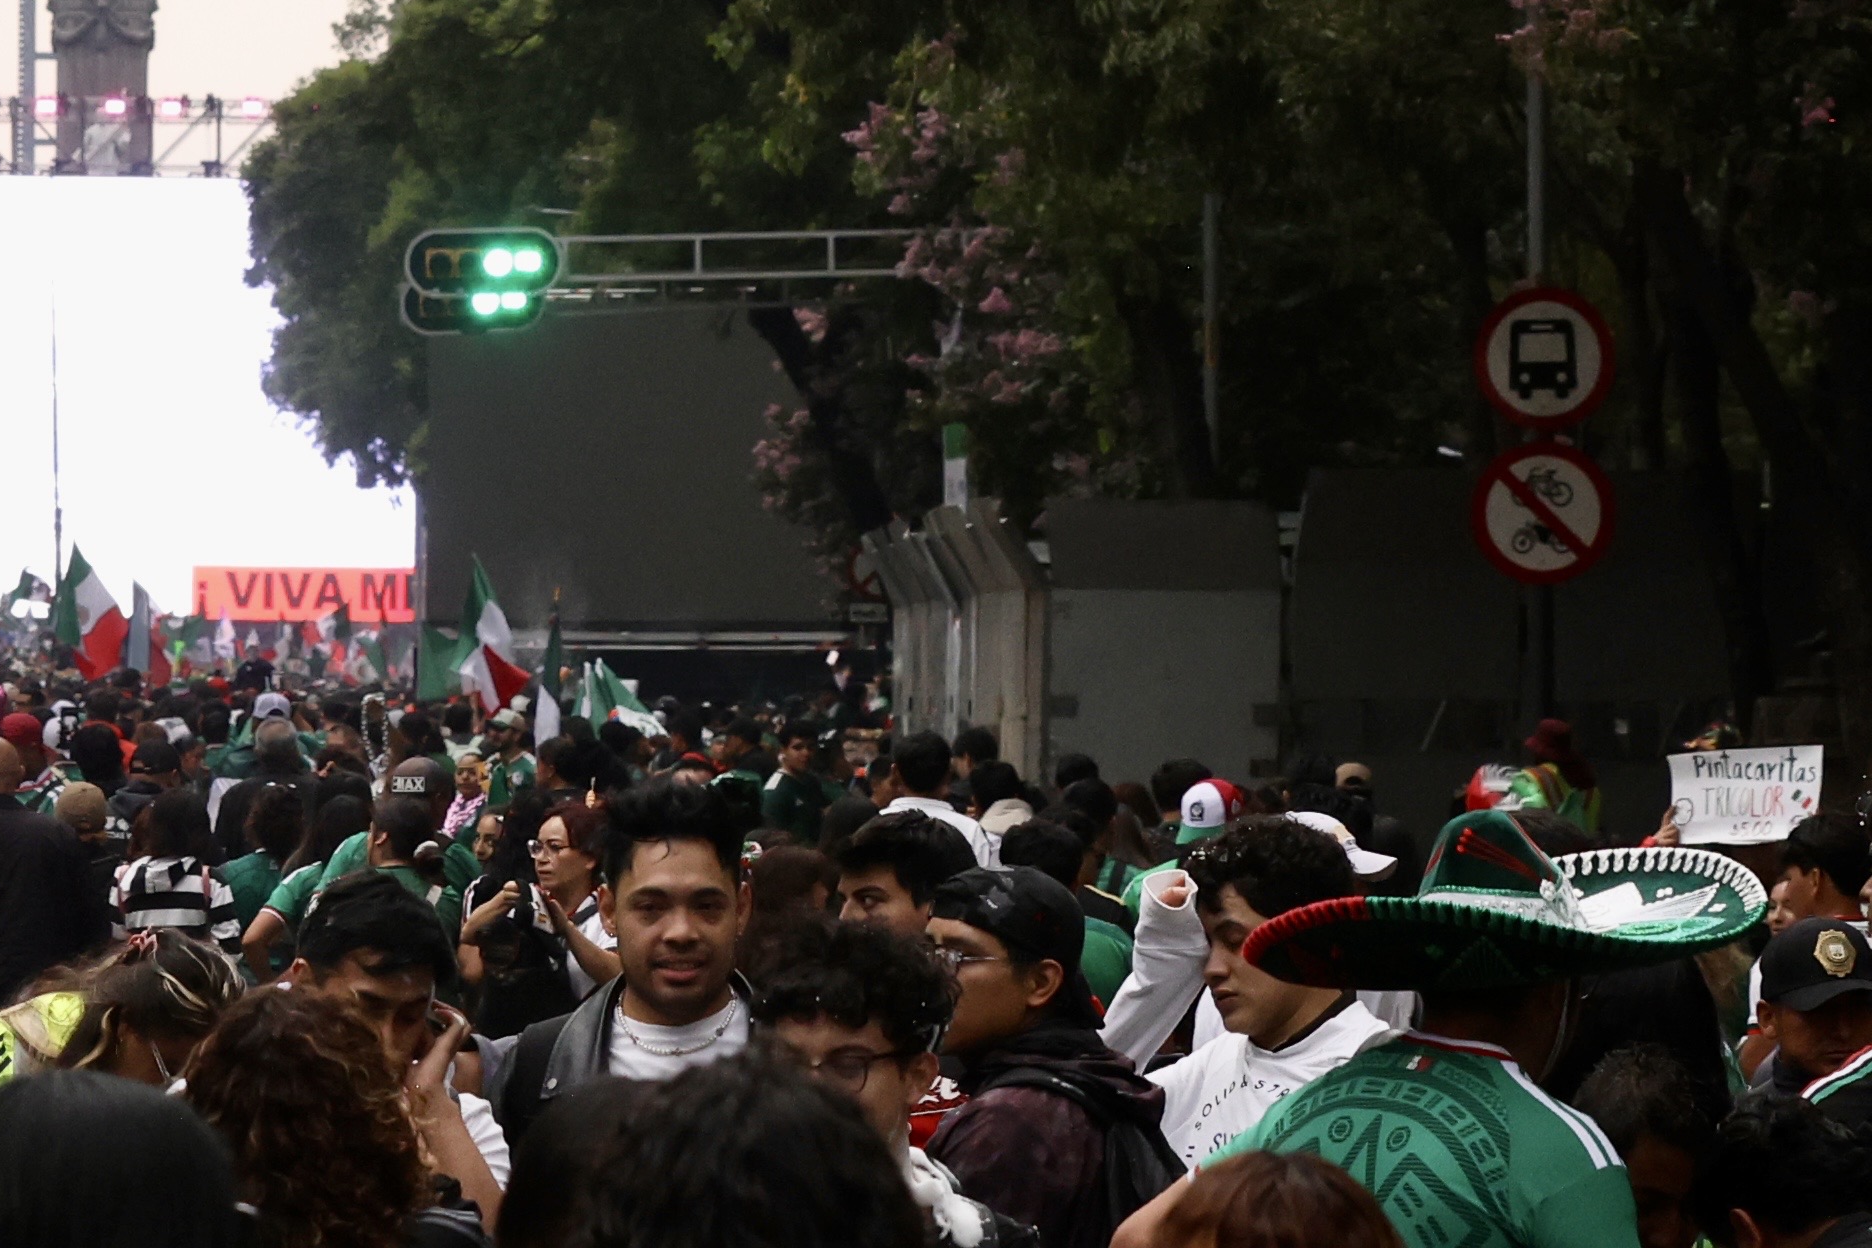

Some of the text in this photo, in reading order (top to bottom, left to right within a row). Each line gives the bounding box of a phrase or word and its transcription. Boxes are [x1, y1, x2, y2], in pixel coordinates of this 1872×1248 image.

[1693, 749, 1817, 783] Pintacaritas
[1702, 786, 1785, 818] TRICOLOR
[1254, 1079, 1291, 1099] STR
